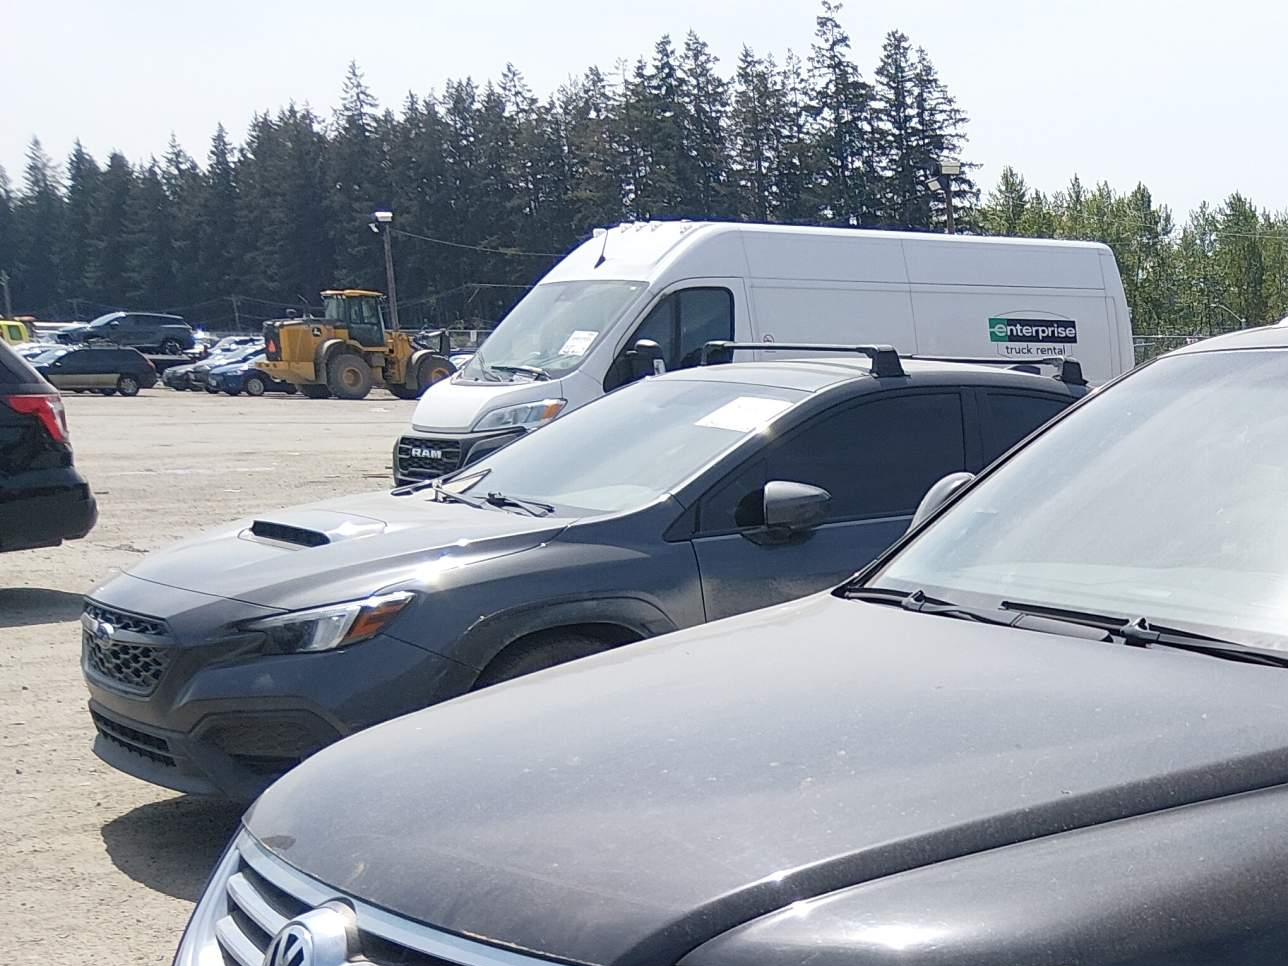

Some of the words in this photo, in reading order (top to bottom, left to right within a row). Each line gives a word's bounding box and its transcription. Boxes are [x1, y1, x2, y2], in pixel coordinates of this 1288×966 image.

[990, 323, 1076, 341] enterprise
[1005, 344, 1033, 355] truck
[1036, 344, 1066, 356] rental
[411, 447, 442, 459] RAM
